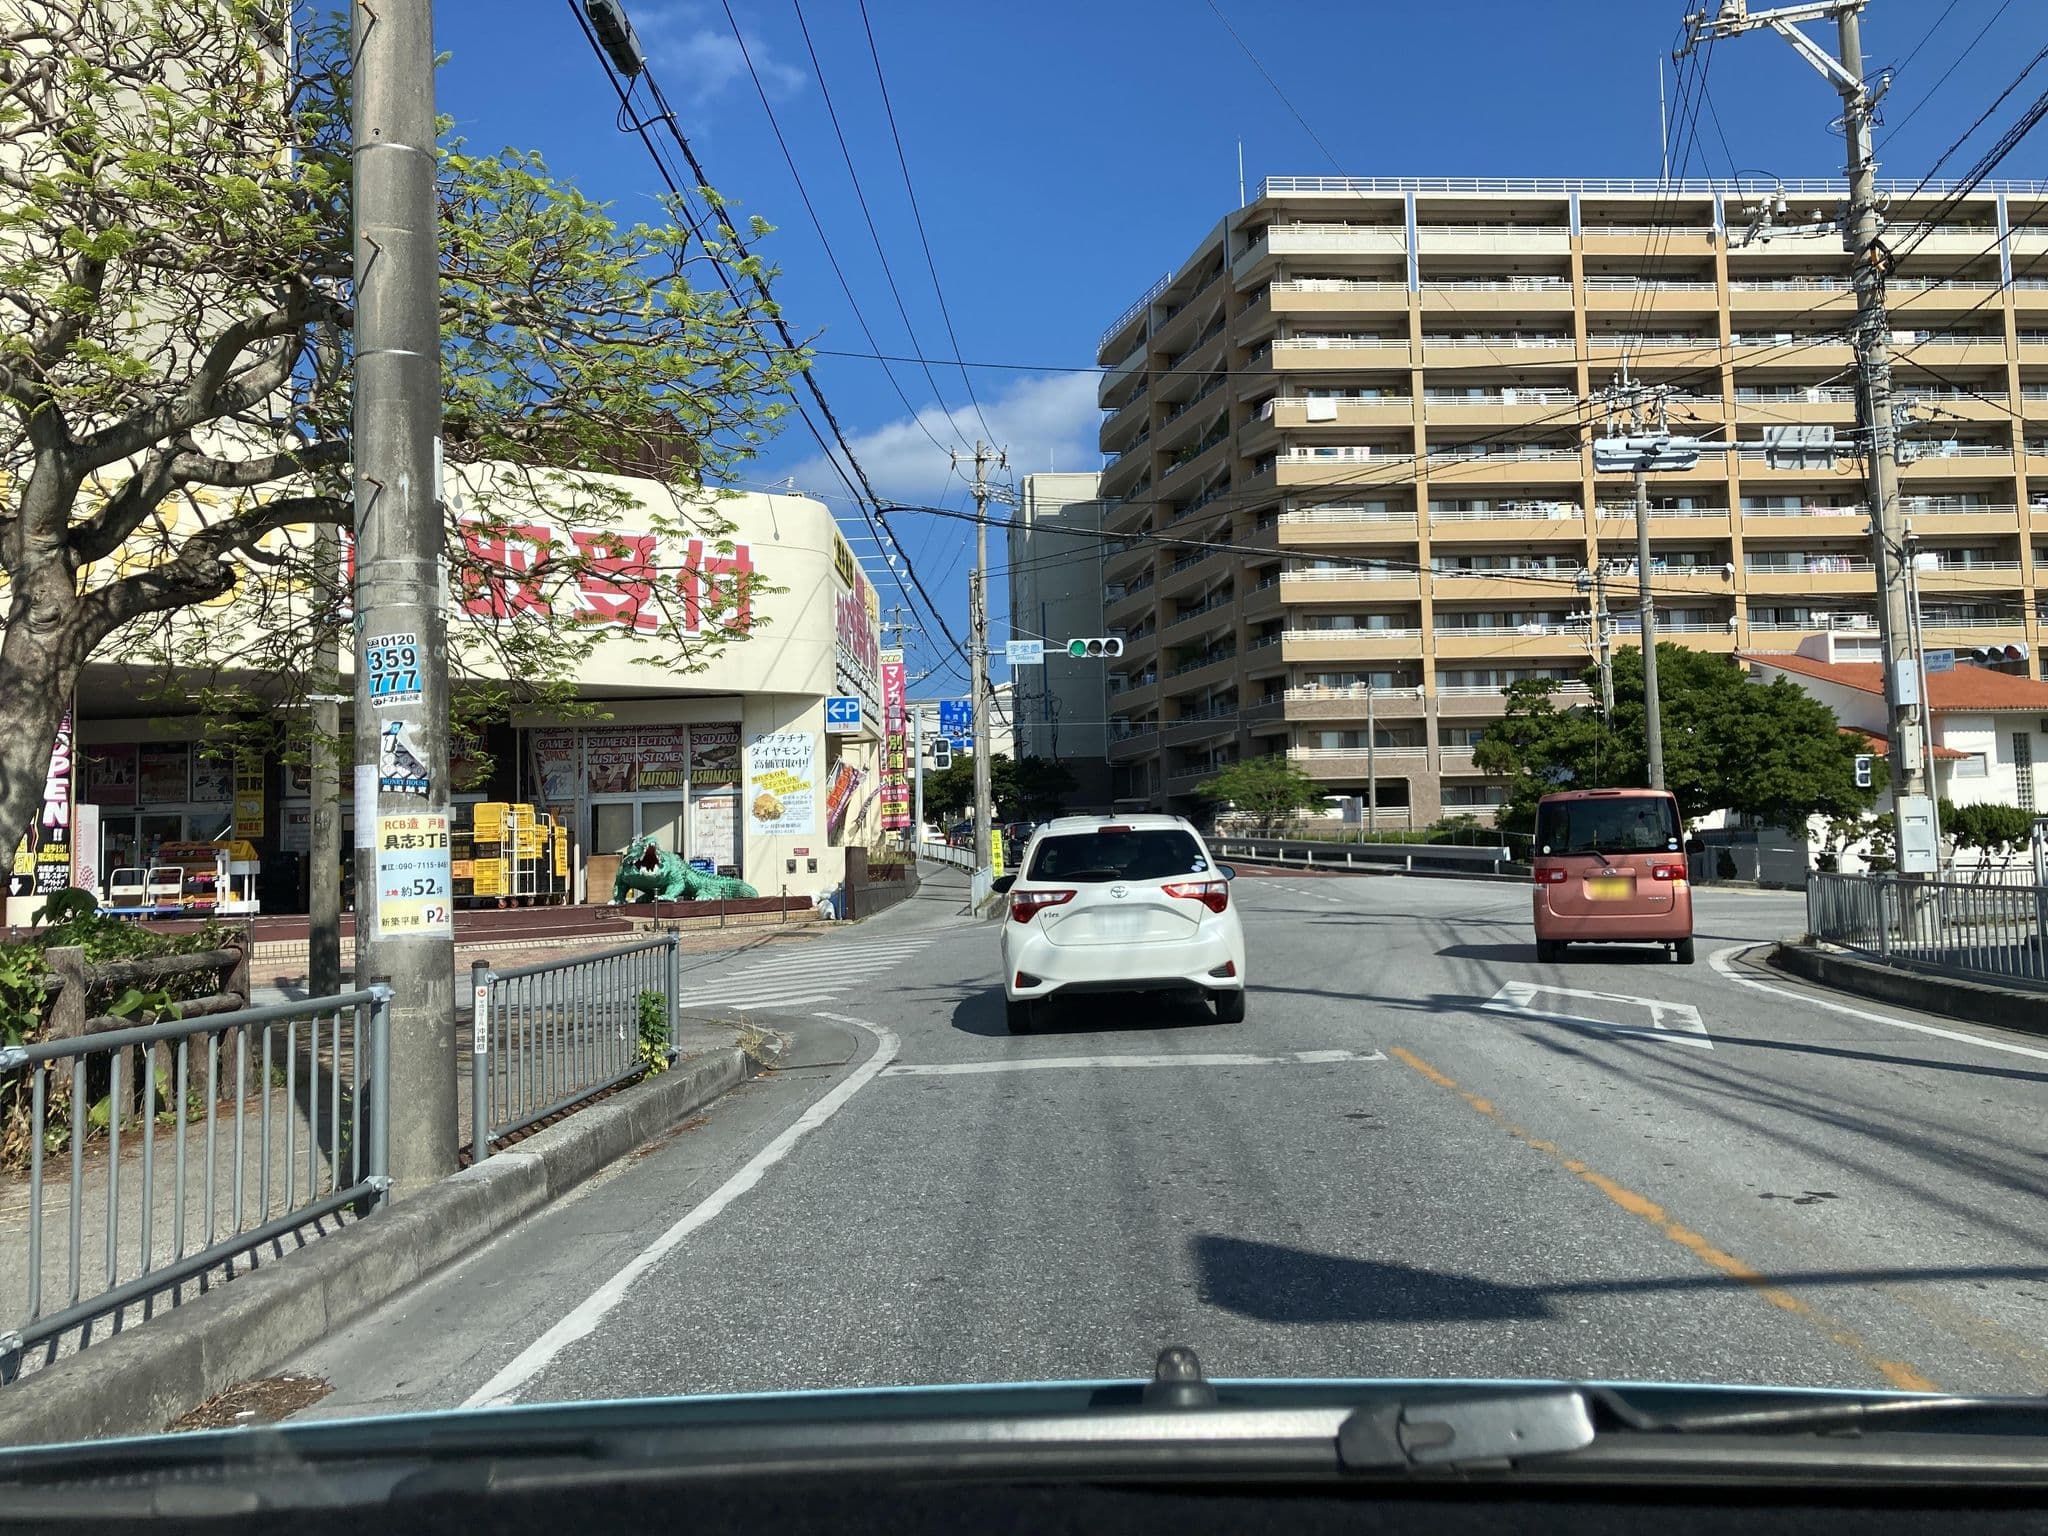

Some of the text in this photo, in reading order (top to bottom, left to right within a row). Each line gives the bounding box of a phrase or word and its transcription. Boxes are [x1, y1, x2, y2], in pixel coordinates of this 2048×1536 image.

[346, 518, 755, 638] 取受付
[381, 635, 415, 647] 0120
[370, 648, 416, 671] 359
[371, 670, 417, 693] 777
[846, 702, 858, 715] P
[757, 734, 807, 744] 金プラチナ
[752, 746, 811, 756] ダイヤモンド
[382, 777, 429, 787] MONEY HOUSE
[882, 773, 906, 786] OPEN
[384, 818, 418, 830] RCB造
[384, 833, 448, 849] 具志3丁目
[382, 915, 420, 927] 新築平屋
